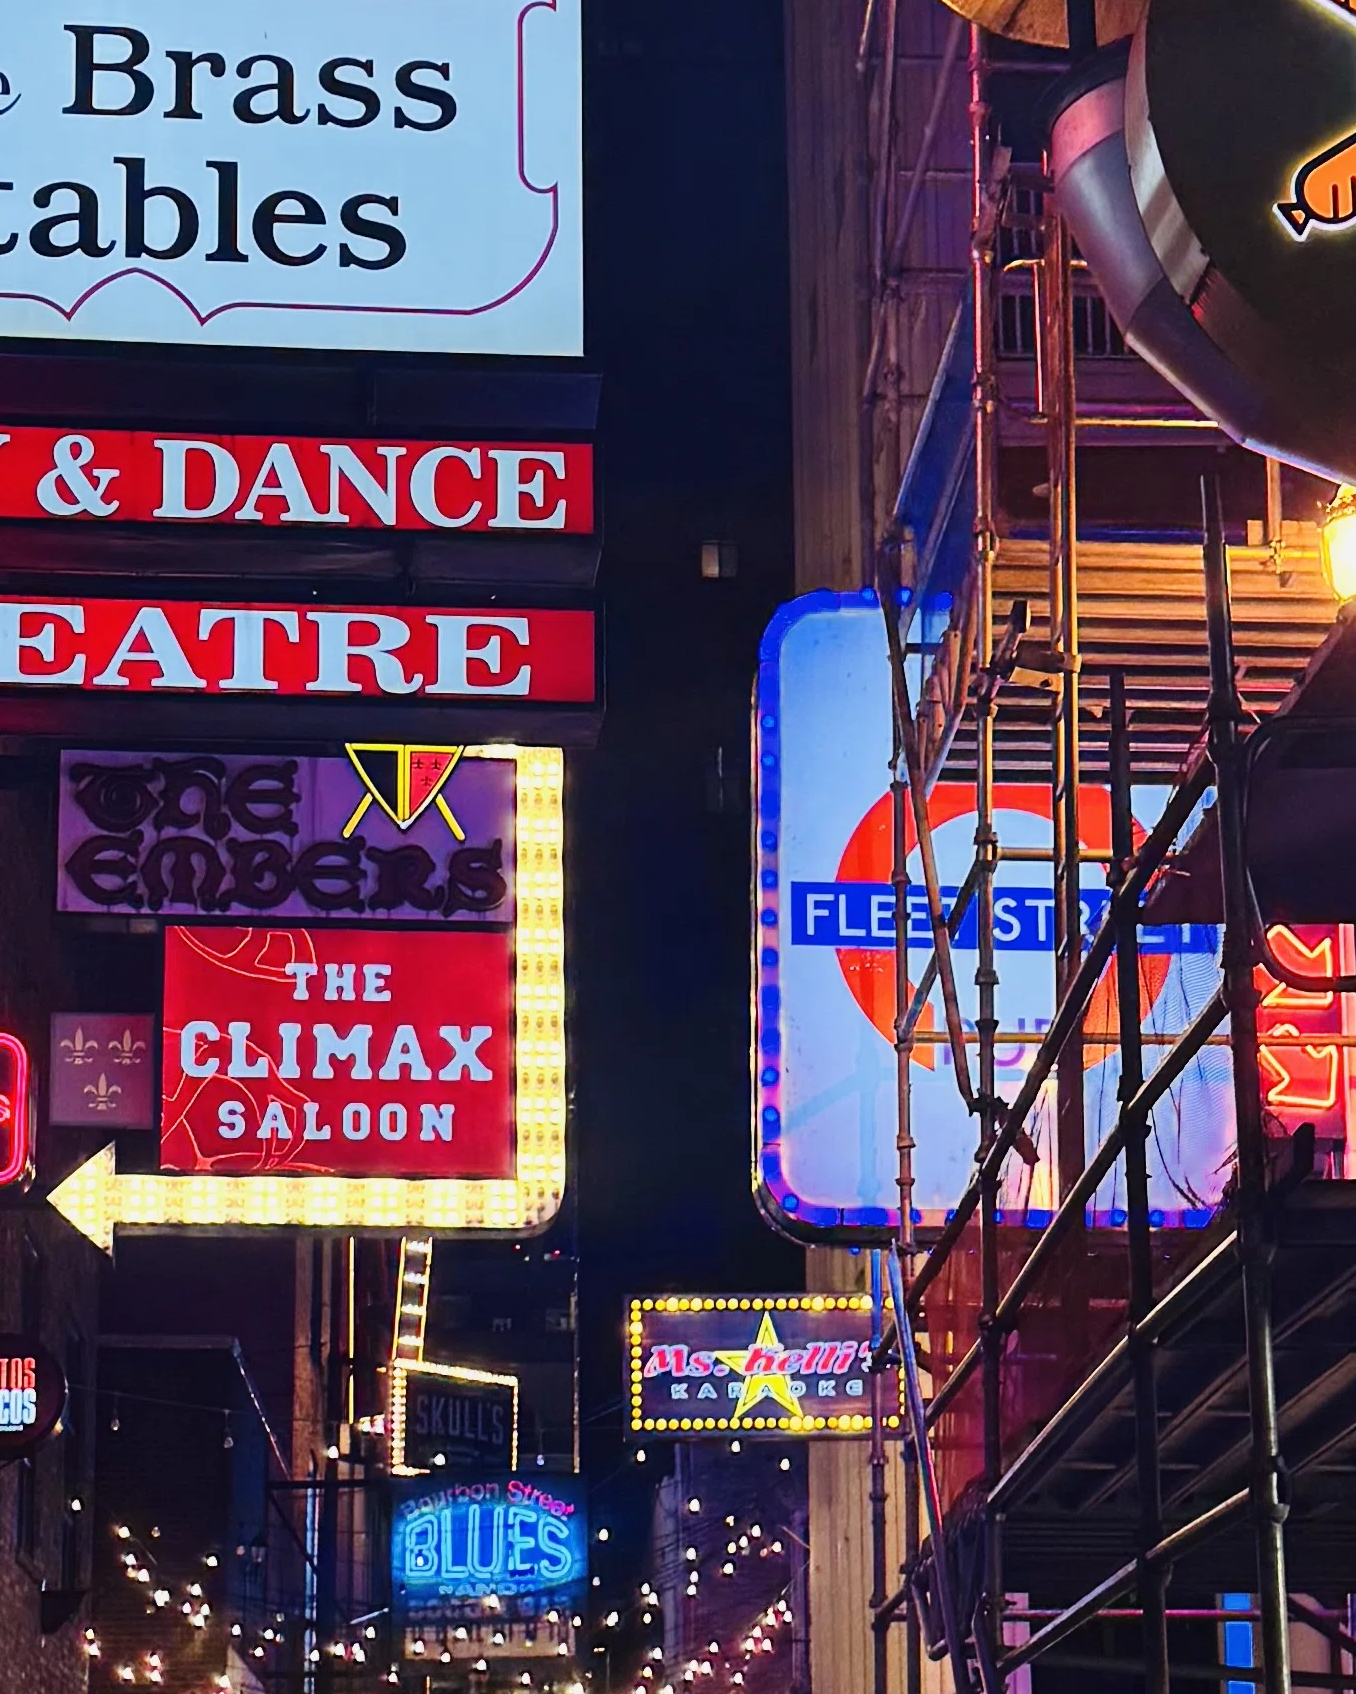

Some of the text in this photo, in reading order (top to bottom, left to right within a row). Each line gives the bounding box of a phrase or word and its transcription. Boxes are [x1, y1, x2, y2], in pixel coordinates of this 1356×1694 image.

[62, 24, 458, 131] Brass
[36, 435, 122, 518] &
[154, 437, 567, 531] DANCE
[64, 829, 507, 917] EMBERS
[285, 963, 392, 1003] THE
[180, 1020, 494, 1082] CLIMAX
[218, 1100, 456, 1142] SALOON
[671, 1379, 864, 1400] KARAOKE
[405, 1503, 573, 1580] BLUES
